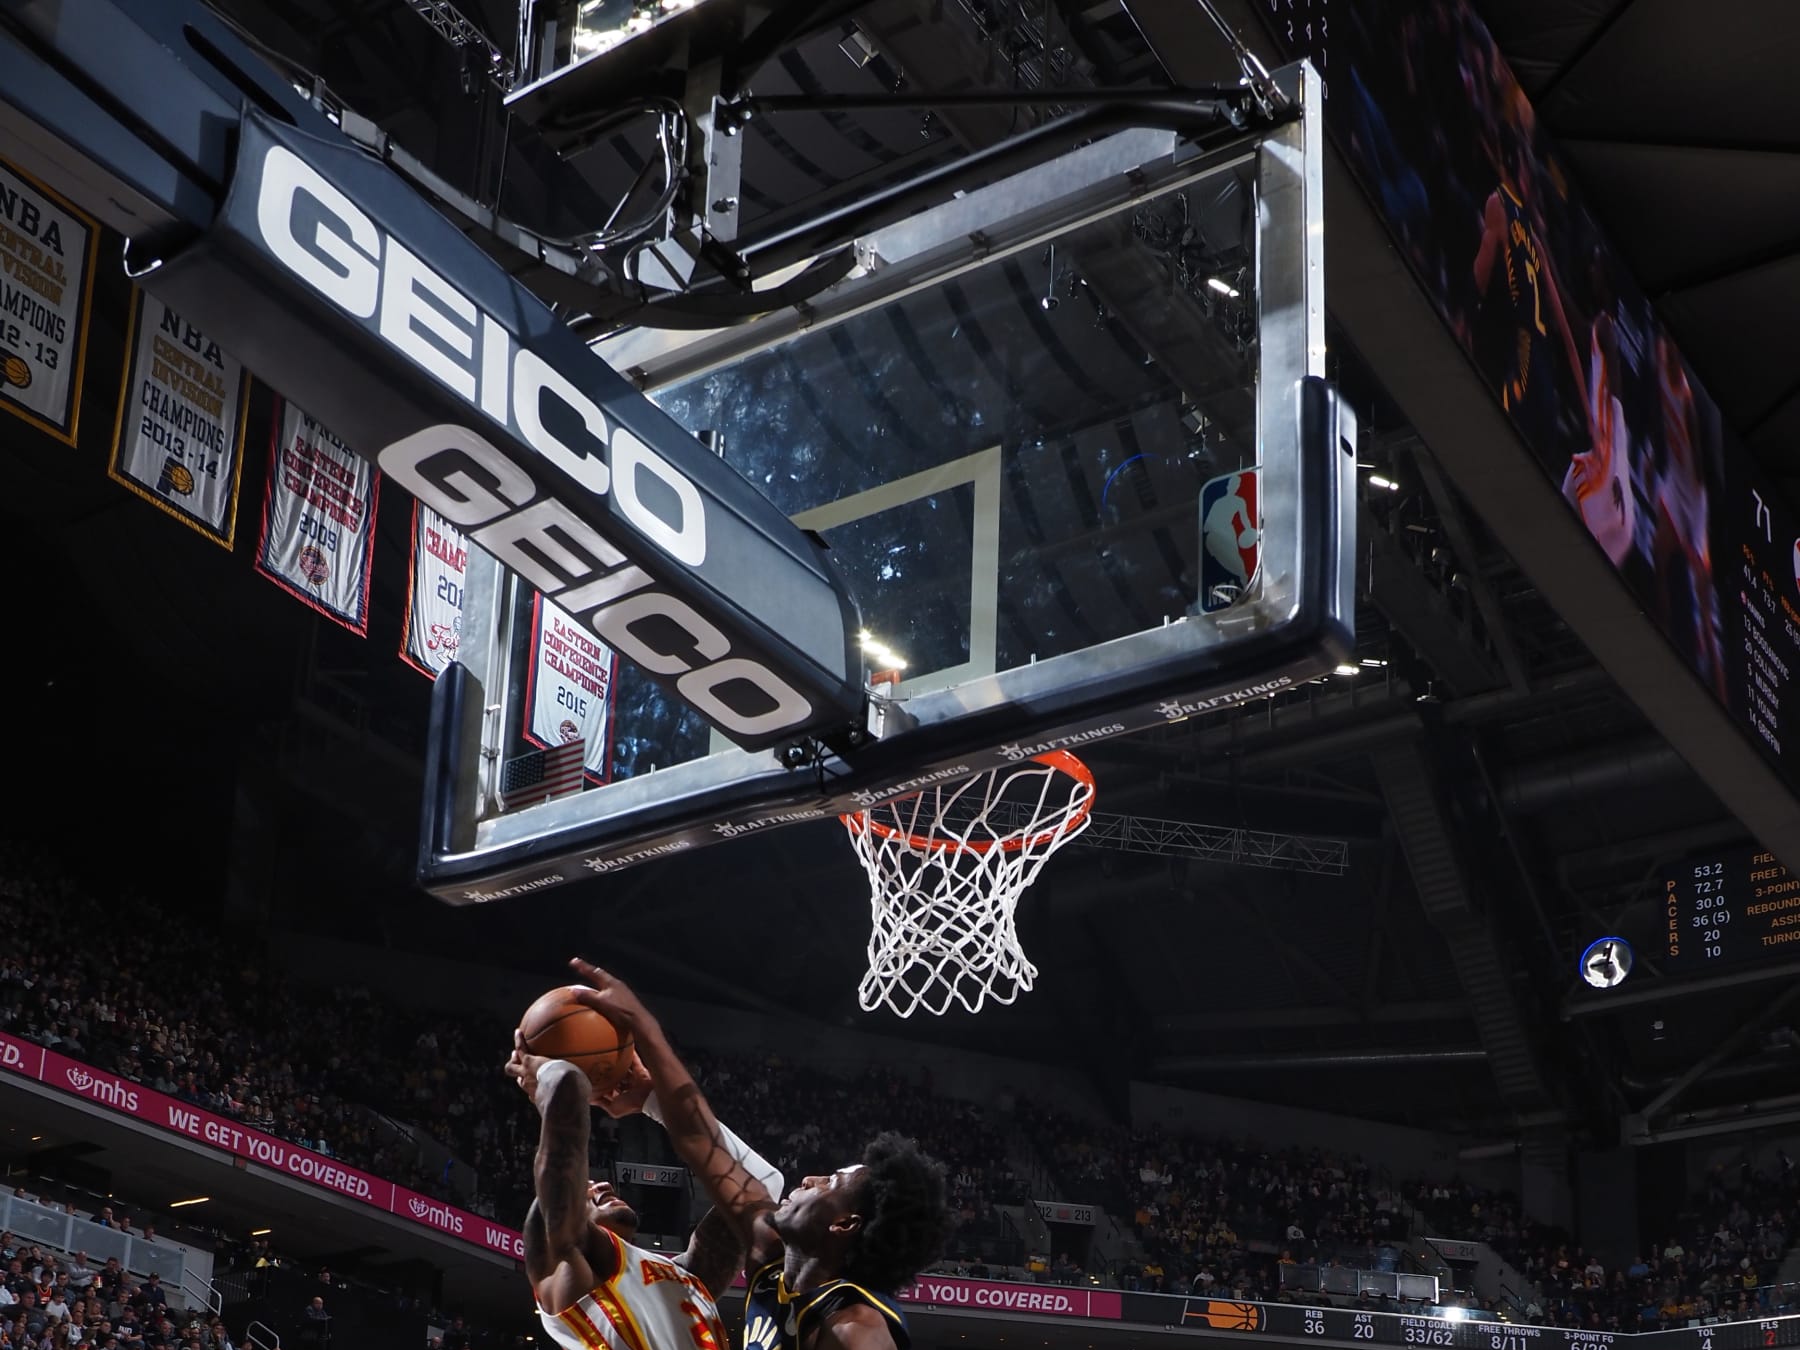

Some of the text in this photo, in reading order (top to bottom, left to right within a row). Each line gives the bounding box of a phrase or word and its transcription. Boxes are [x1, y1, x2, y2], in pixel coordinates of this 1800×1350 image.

[0, 182, 64, 256] NBA
[160, 306, 225, 369] NBA
[153, 334, 225, 399] CENTRAL
[257, 144, 708, 567] GEICO
[151, 356, 223, 420] DIVISION
[141, 380, 225, 454] CHAMPIONS
[295, 435, 356, 490] EASTERN
[283, 448, 363, 517] CONFERENCE
[284, 470, 359, 534] CHAMPIONS
[299, 512, 337, 552] 2009
[378, 424, 813, 735] GEICO
[553, 616, 600, 662] EASTERN
[543, 631, 608, 684] CONFERENCE
[544, 649, 605, 701] CHAMPIONS
[556, 685, 587, 719] 2015
[1164, 675, 1293, 720] DRAFTKINGS
[1007, 722, 1126, 761] DRAFTKINGS
[860, 763, 970, 806] DRAFTKINGS
[720, 806, 826, 839] DRAFTKINGS
[592, 839, 690, 873] DRAFTKINGS
[1694, 863, 1723, 878] 53.2
[473, 873, 564, 904] DRAFTKINGS
[1694, 879, 1723, 894] 72.7
[1750, 868, 1778, 882] FREE
[1692, 910, 1730, 927] 36 (5)
[1696, 895, 1725, 910] 30.0
[1704, 929, 1720, 942] 20
[1705, 945, 1721, 957] 10
[93, 1078, 374, 1200] mhs WE GET YOU COVERED.
[661, 1171, 679, 1183] 212
[428, 1205, 464, 1234] mhs
[486, 1227, 511, 1251] WE
[1074, 1209, 1091, 1221] 213
[929, 1284, 970, 1302] YOU
[975, 1288, 1073, 1312] COVERED.
[1304, 1320, 1325, 1335] 36
[1305, 1309, 1323, 1320] REB
[1354, 1313, 1373, 1323] AST
[1400, 1318, 1457, 1331] FIELD GOALS
[1761, 1320, 1779, 1330] FLS
[1353, 1324, 1374, 1339] 20
[1405, 1328, 1454, 1346] 33/62
[1478, 1324, 1541, 1338] FREE THROWS
[1564, 1331, 1614, 1343] 3-POINT FG
[1697, 1329, 1716, 1337] TOL
[1765, 1330, 1776, 1346] 2
